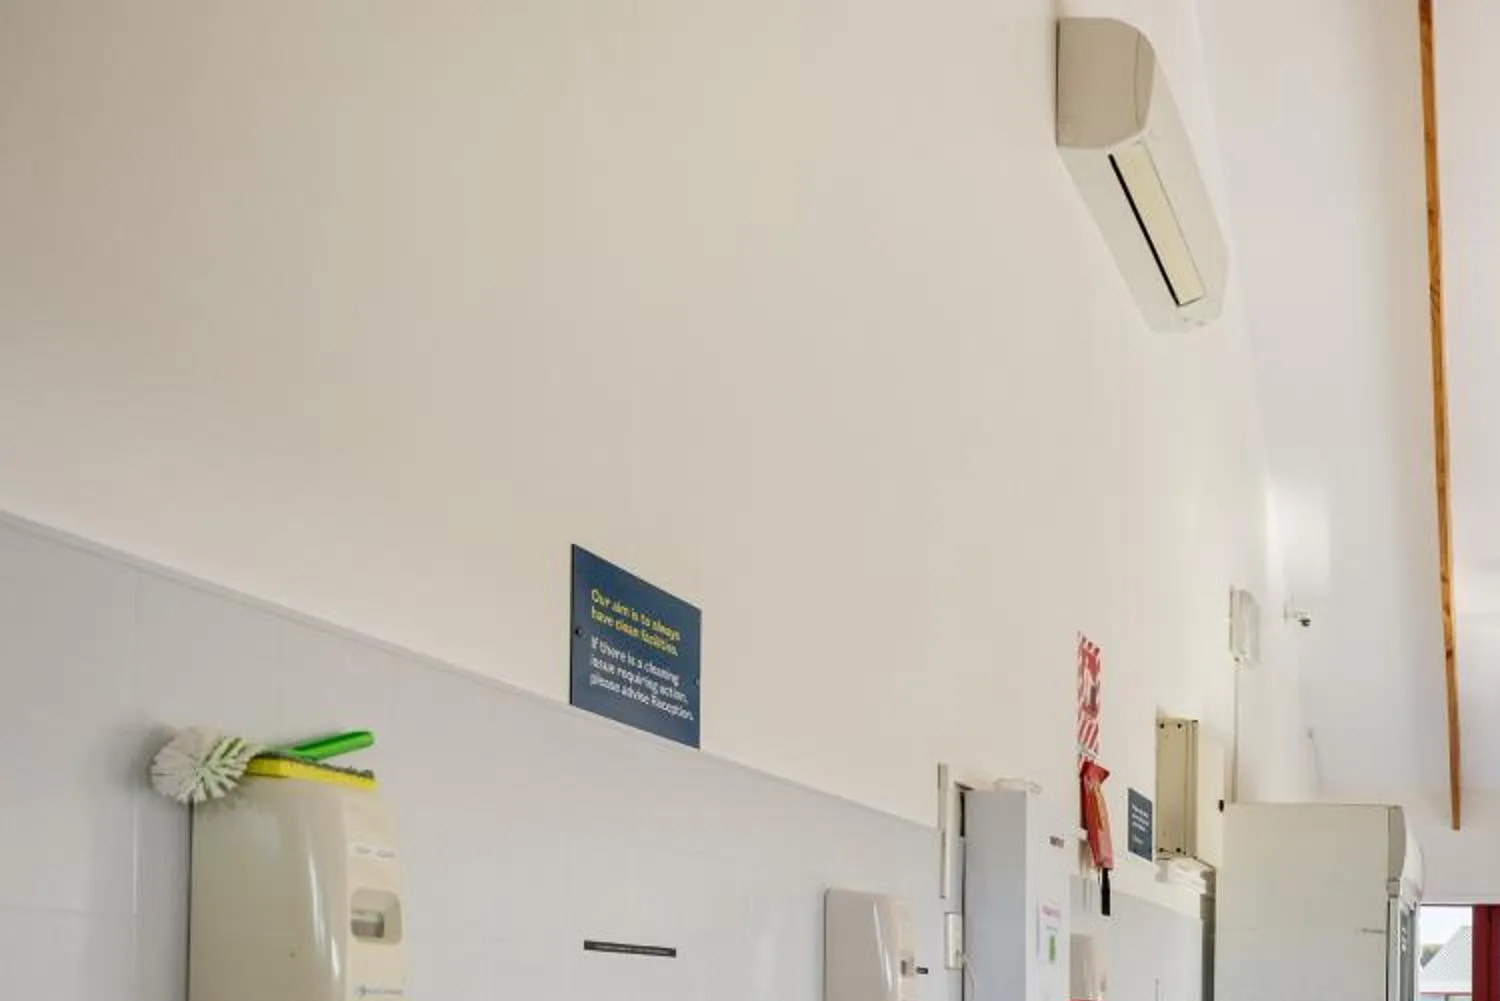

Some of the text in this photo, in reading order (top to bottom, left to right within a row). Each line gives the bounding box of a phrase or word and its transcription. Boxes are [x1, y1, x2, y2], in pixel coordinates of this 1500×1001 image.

[591, 588, 610, 608] Our
[640, 613, 650, 627] to
[651, 619, 681, 641] always
[591, 606, 614, 627] have
[591, 635, 599, 649] If
[600, 640, 626, 662] there
[644, 661, 680, 687] cleaning
[590, 673, 620, 692] please
[617, 667, 658, 695] requiring
